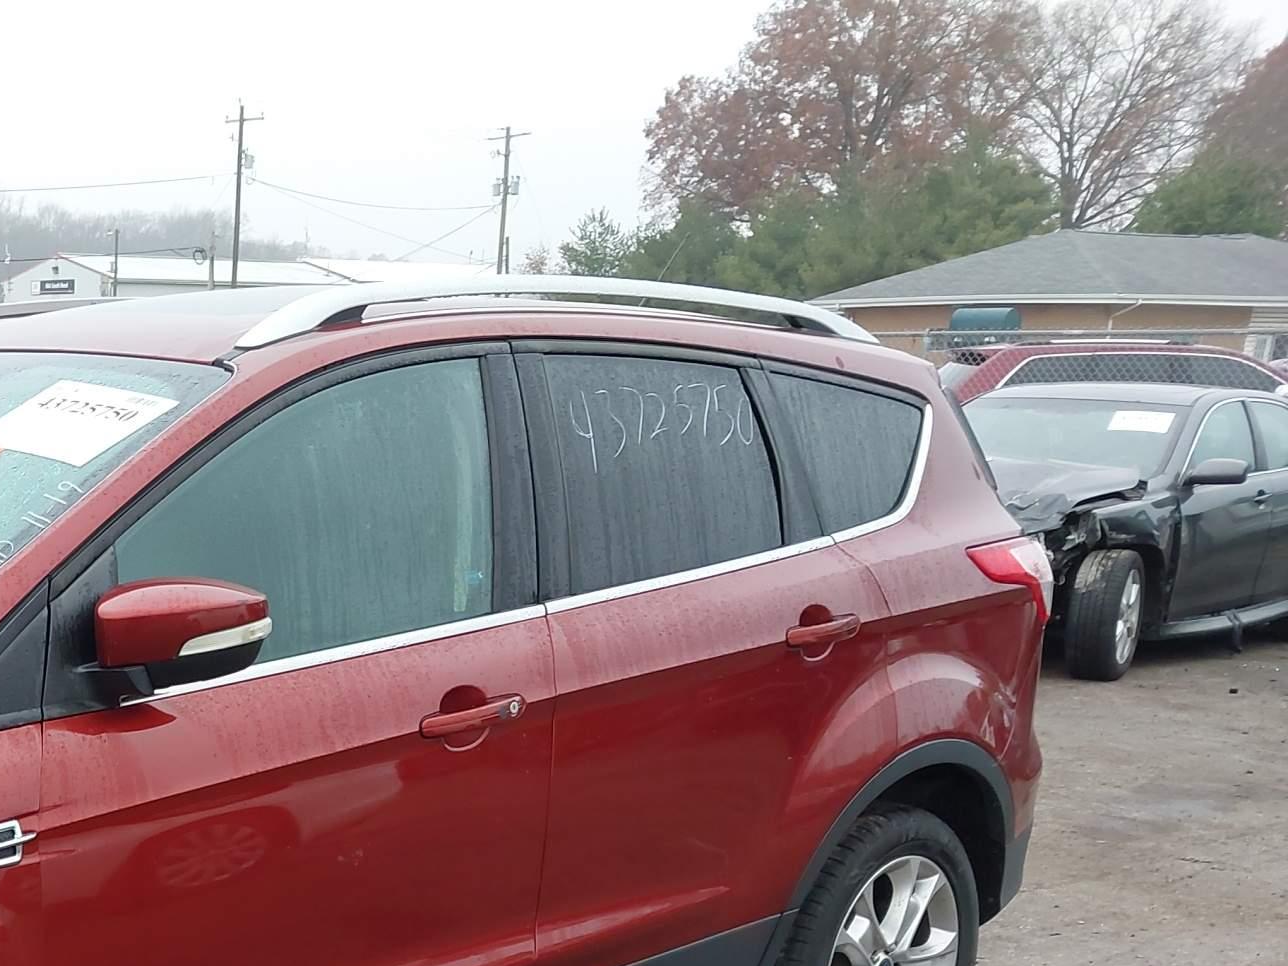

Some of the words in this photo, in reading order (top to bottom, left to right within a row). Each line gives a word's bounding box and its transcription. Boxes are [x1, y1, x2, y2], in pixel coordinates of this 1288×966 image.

[37, 396, 140, 422] 43725750
[569, 382, 755, 474] 43725750
[21, 480, 85, 530] 11-19
